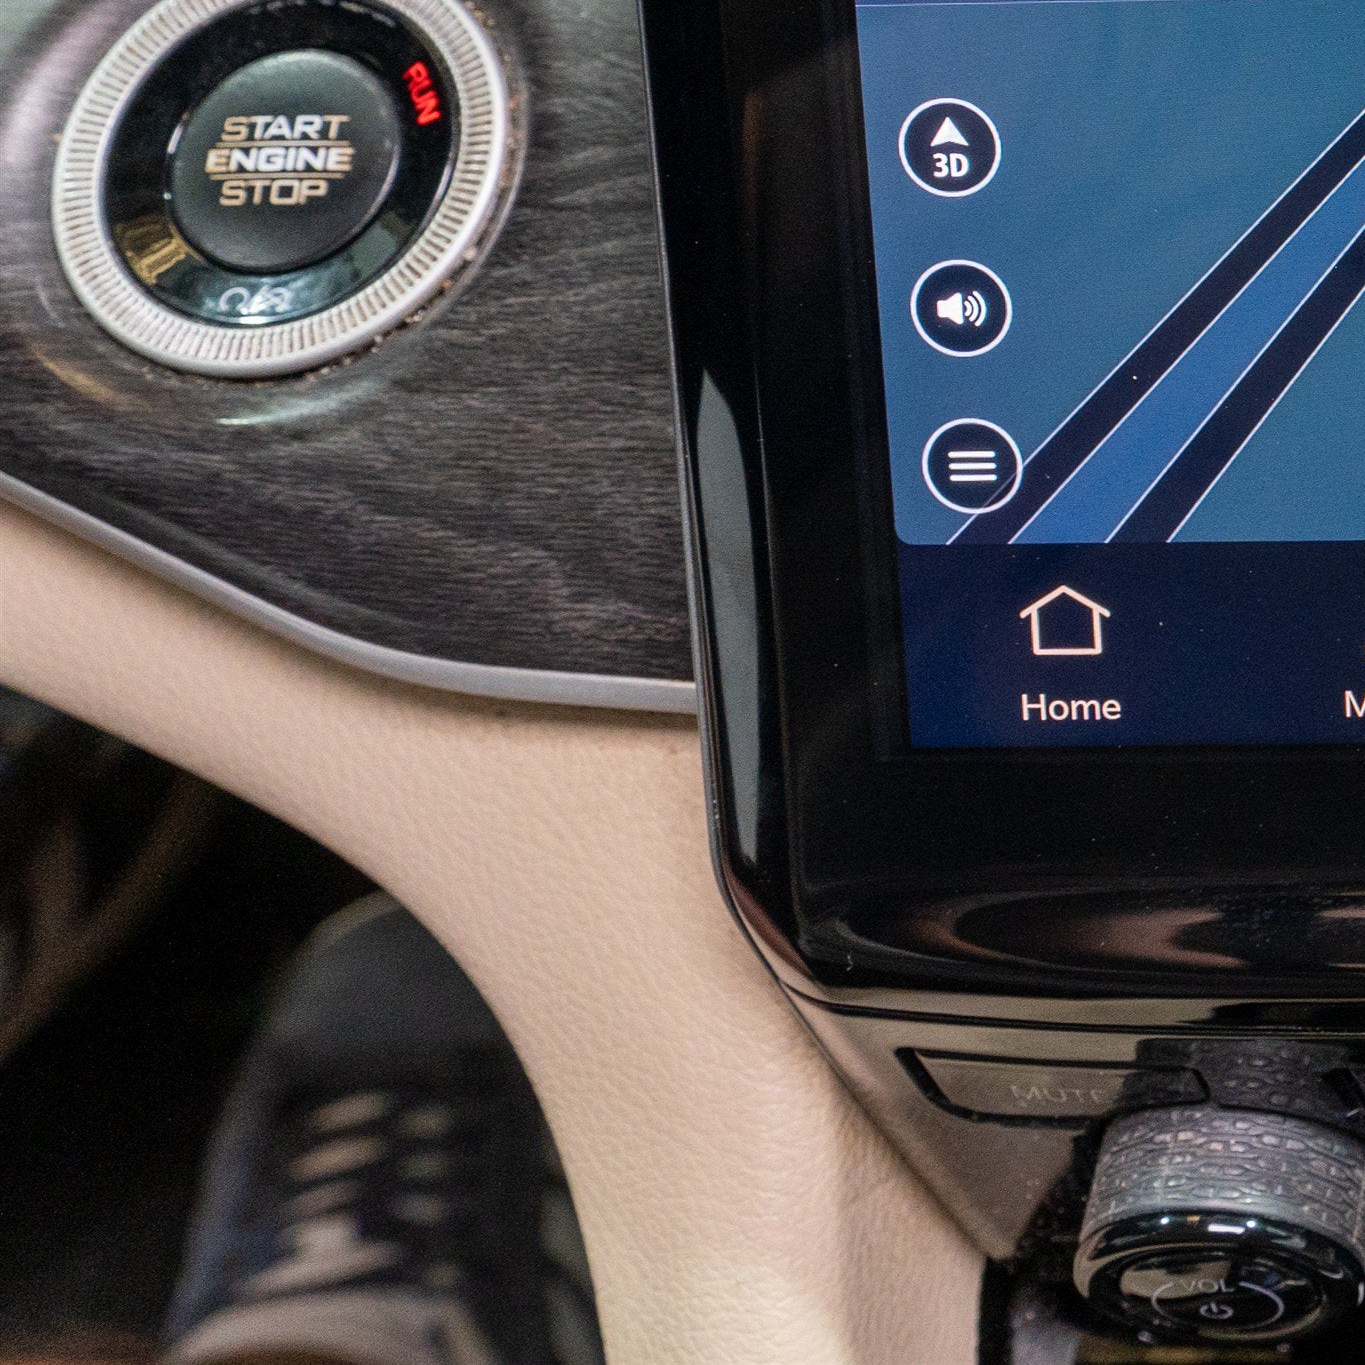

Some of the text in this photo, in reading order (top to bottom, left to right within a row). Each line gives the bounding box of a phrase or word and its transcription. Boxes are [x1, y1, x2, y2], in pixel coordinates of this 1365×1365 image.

[403, 62, 440, 125] RUN
[221, 115, 350, 142] START
[206, 146, 352, 173] ENGINE
[933, 153, 969, 178] 3D
[219, 180, 327, 206] STOP
[1020, 693, 1122, 722] Home
